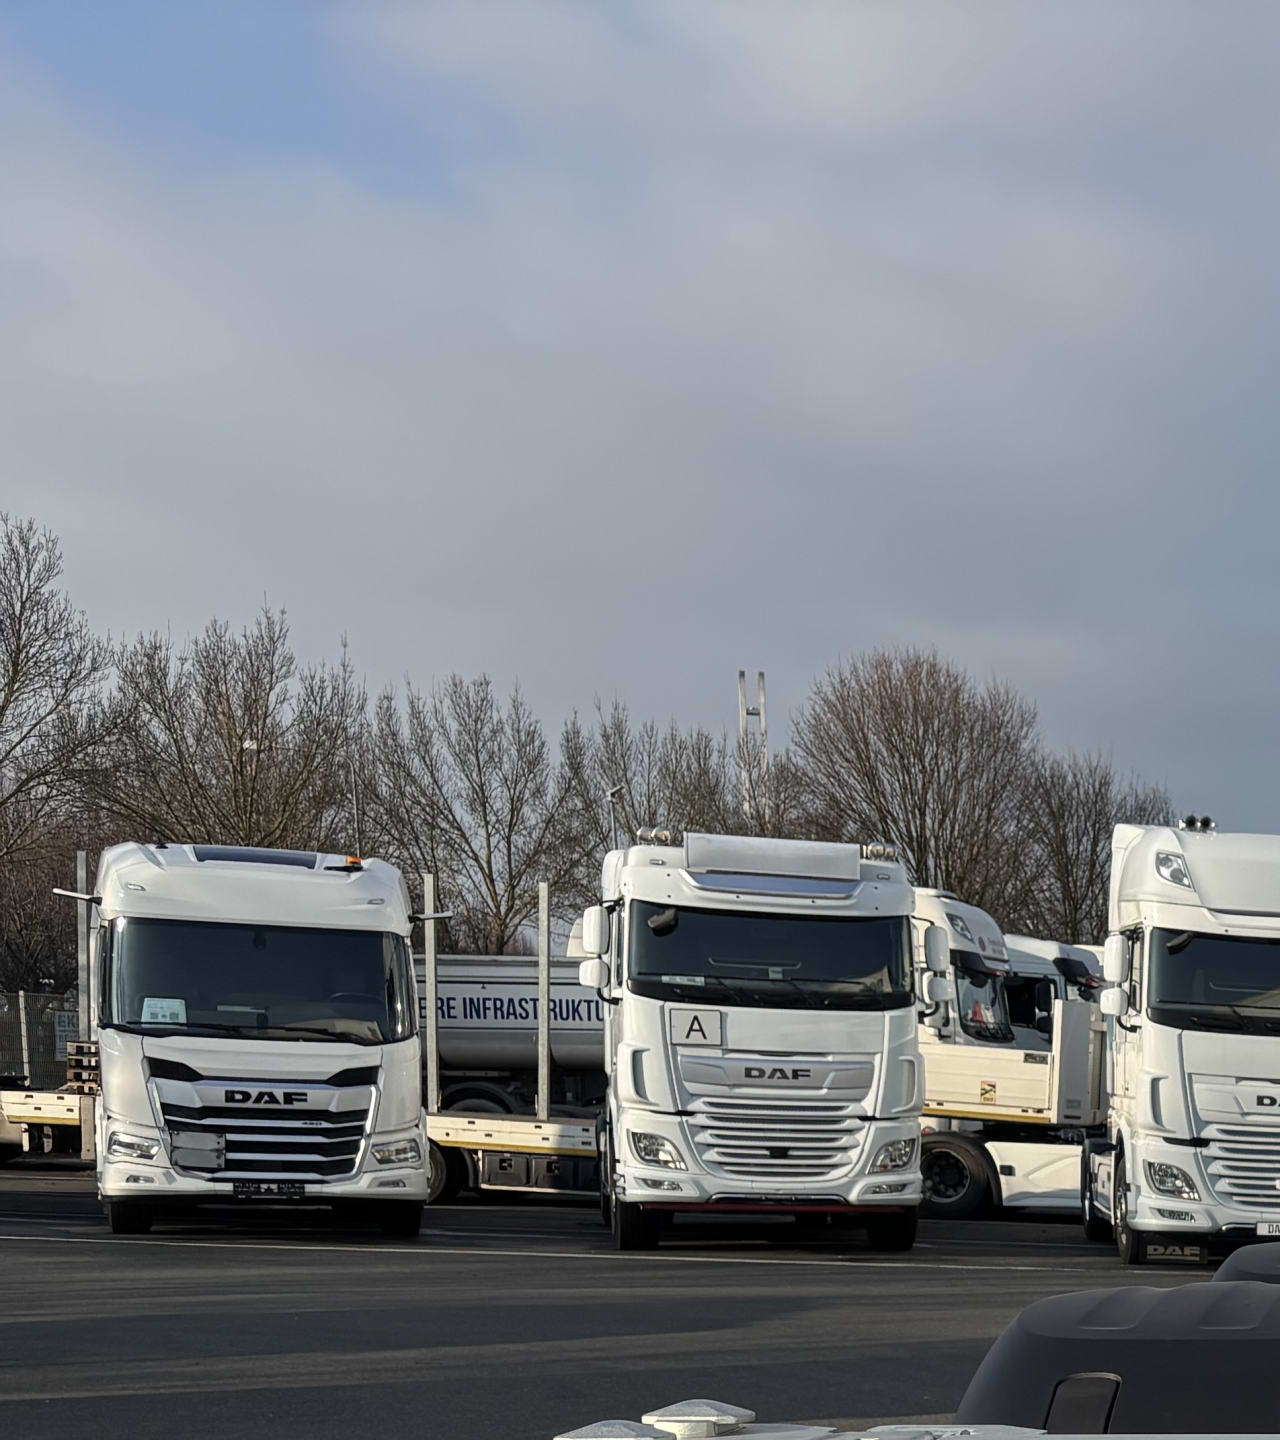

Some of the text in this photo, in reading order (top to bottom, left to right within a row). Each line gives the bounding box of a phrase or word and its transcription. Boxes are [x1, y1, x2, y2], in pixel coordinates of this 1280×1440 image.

[685, 1014, 708, 1041] A
[743, 1066, 812, 1081] DAF
[224, 1089, 308, 1105] DAF
[1146, 1244, 1200, 1256] DAF
